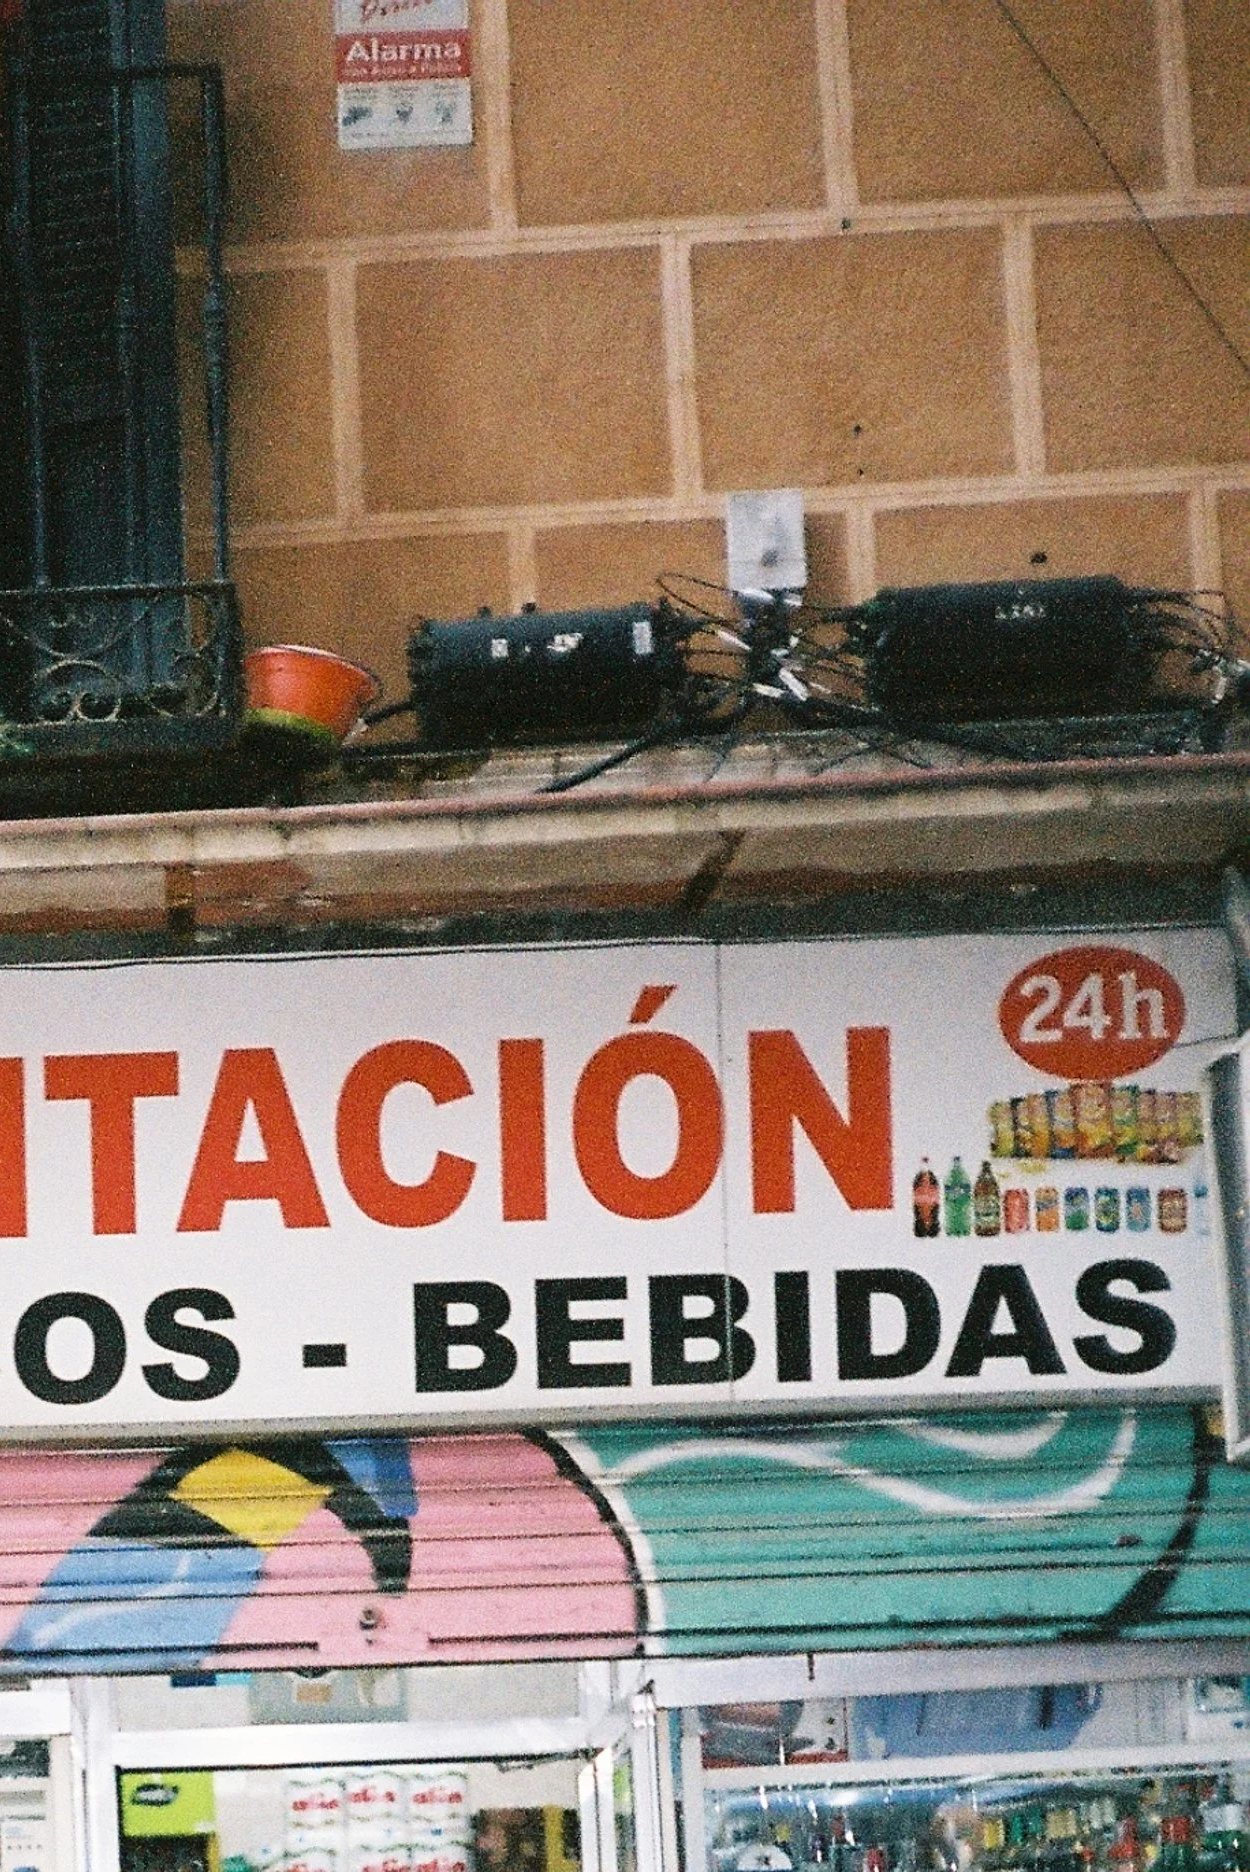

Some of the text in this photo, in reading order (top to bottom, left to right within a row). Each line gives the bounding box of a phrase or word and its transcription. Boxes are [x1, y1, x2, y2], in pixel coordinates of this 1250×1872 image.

[345, 36, 462, 63] Alarma
[1019, 970, 1169, 1044] 24h
[413, 1260, 1176, 1392] BEBIDAS
